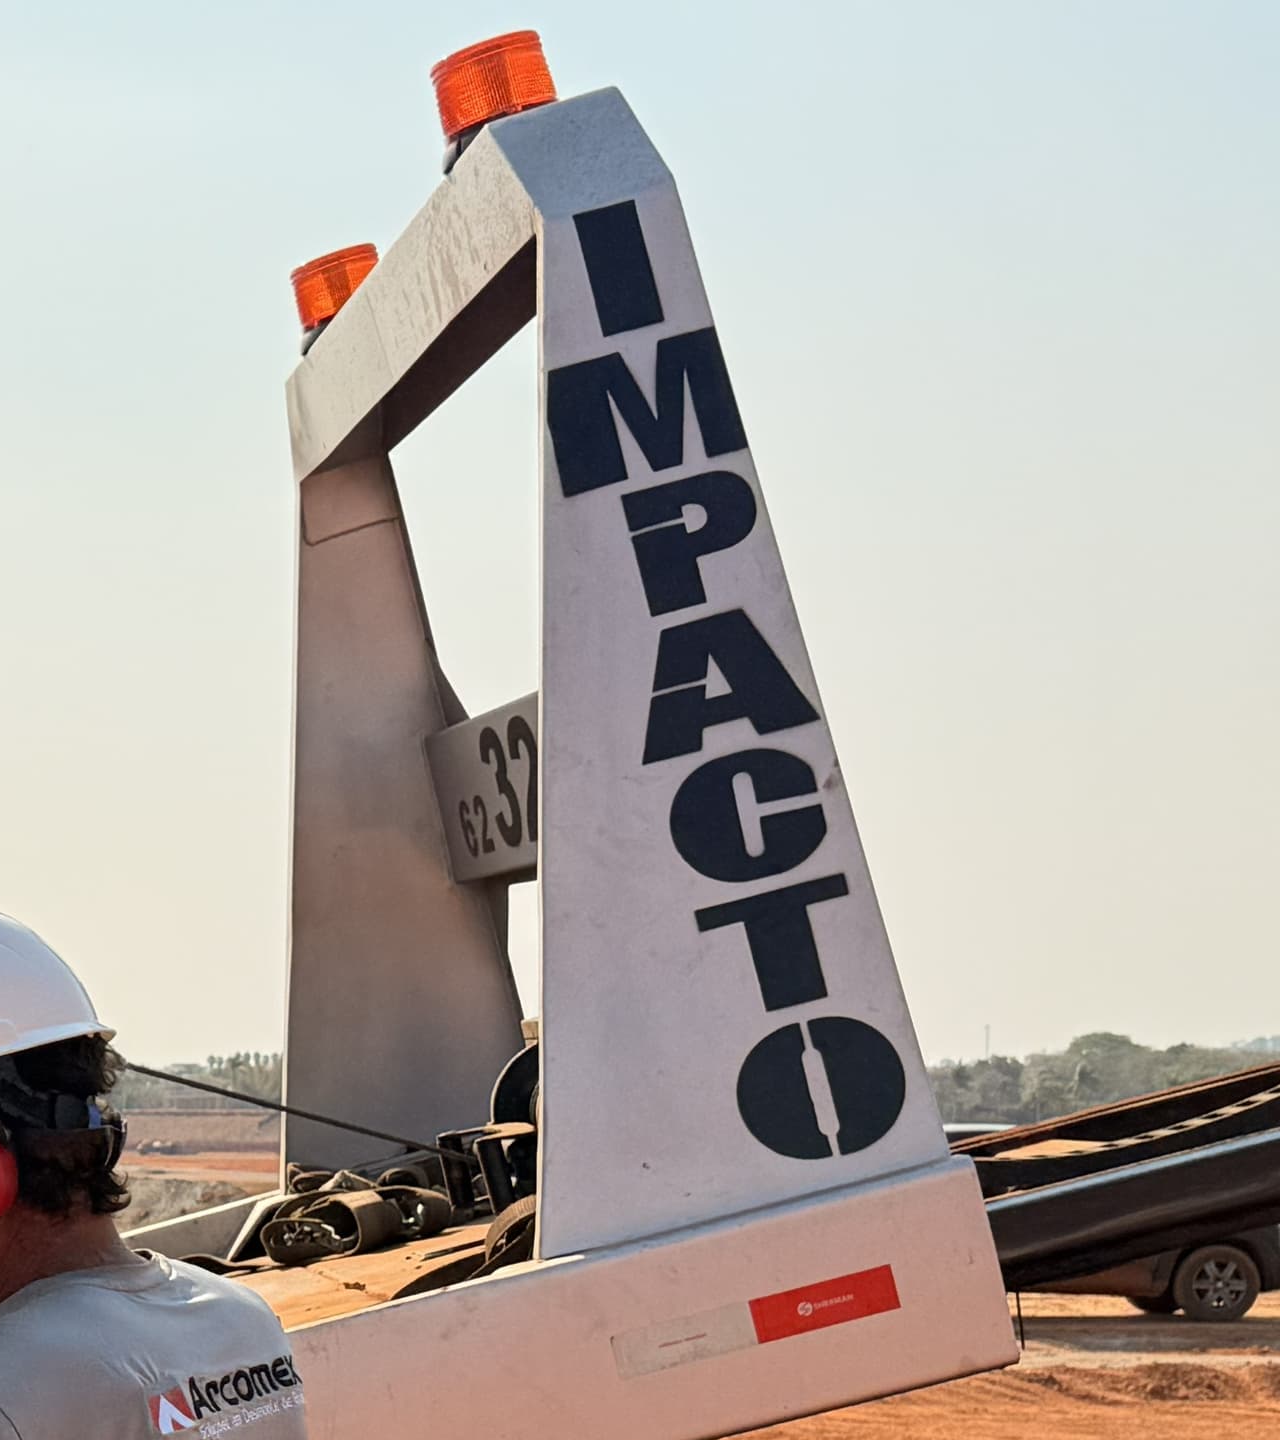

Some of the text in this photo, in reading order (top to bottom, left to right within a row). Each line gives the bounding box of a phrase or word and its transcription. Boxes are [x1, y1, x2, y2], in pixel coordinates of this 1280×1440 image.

[547, 200, 906, 1159] IMPACTO
[459, 795, 496, 858] 62
[188, 1354, 303, 1420] Arcomex
